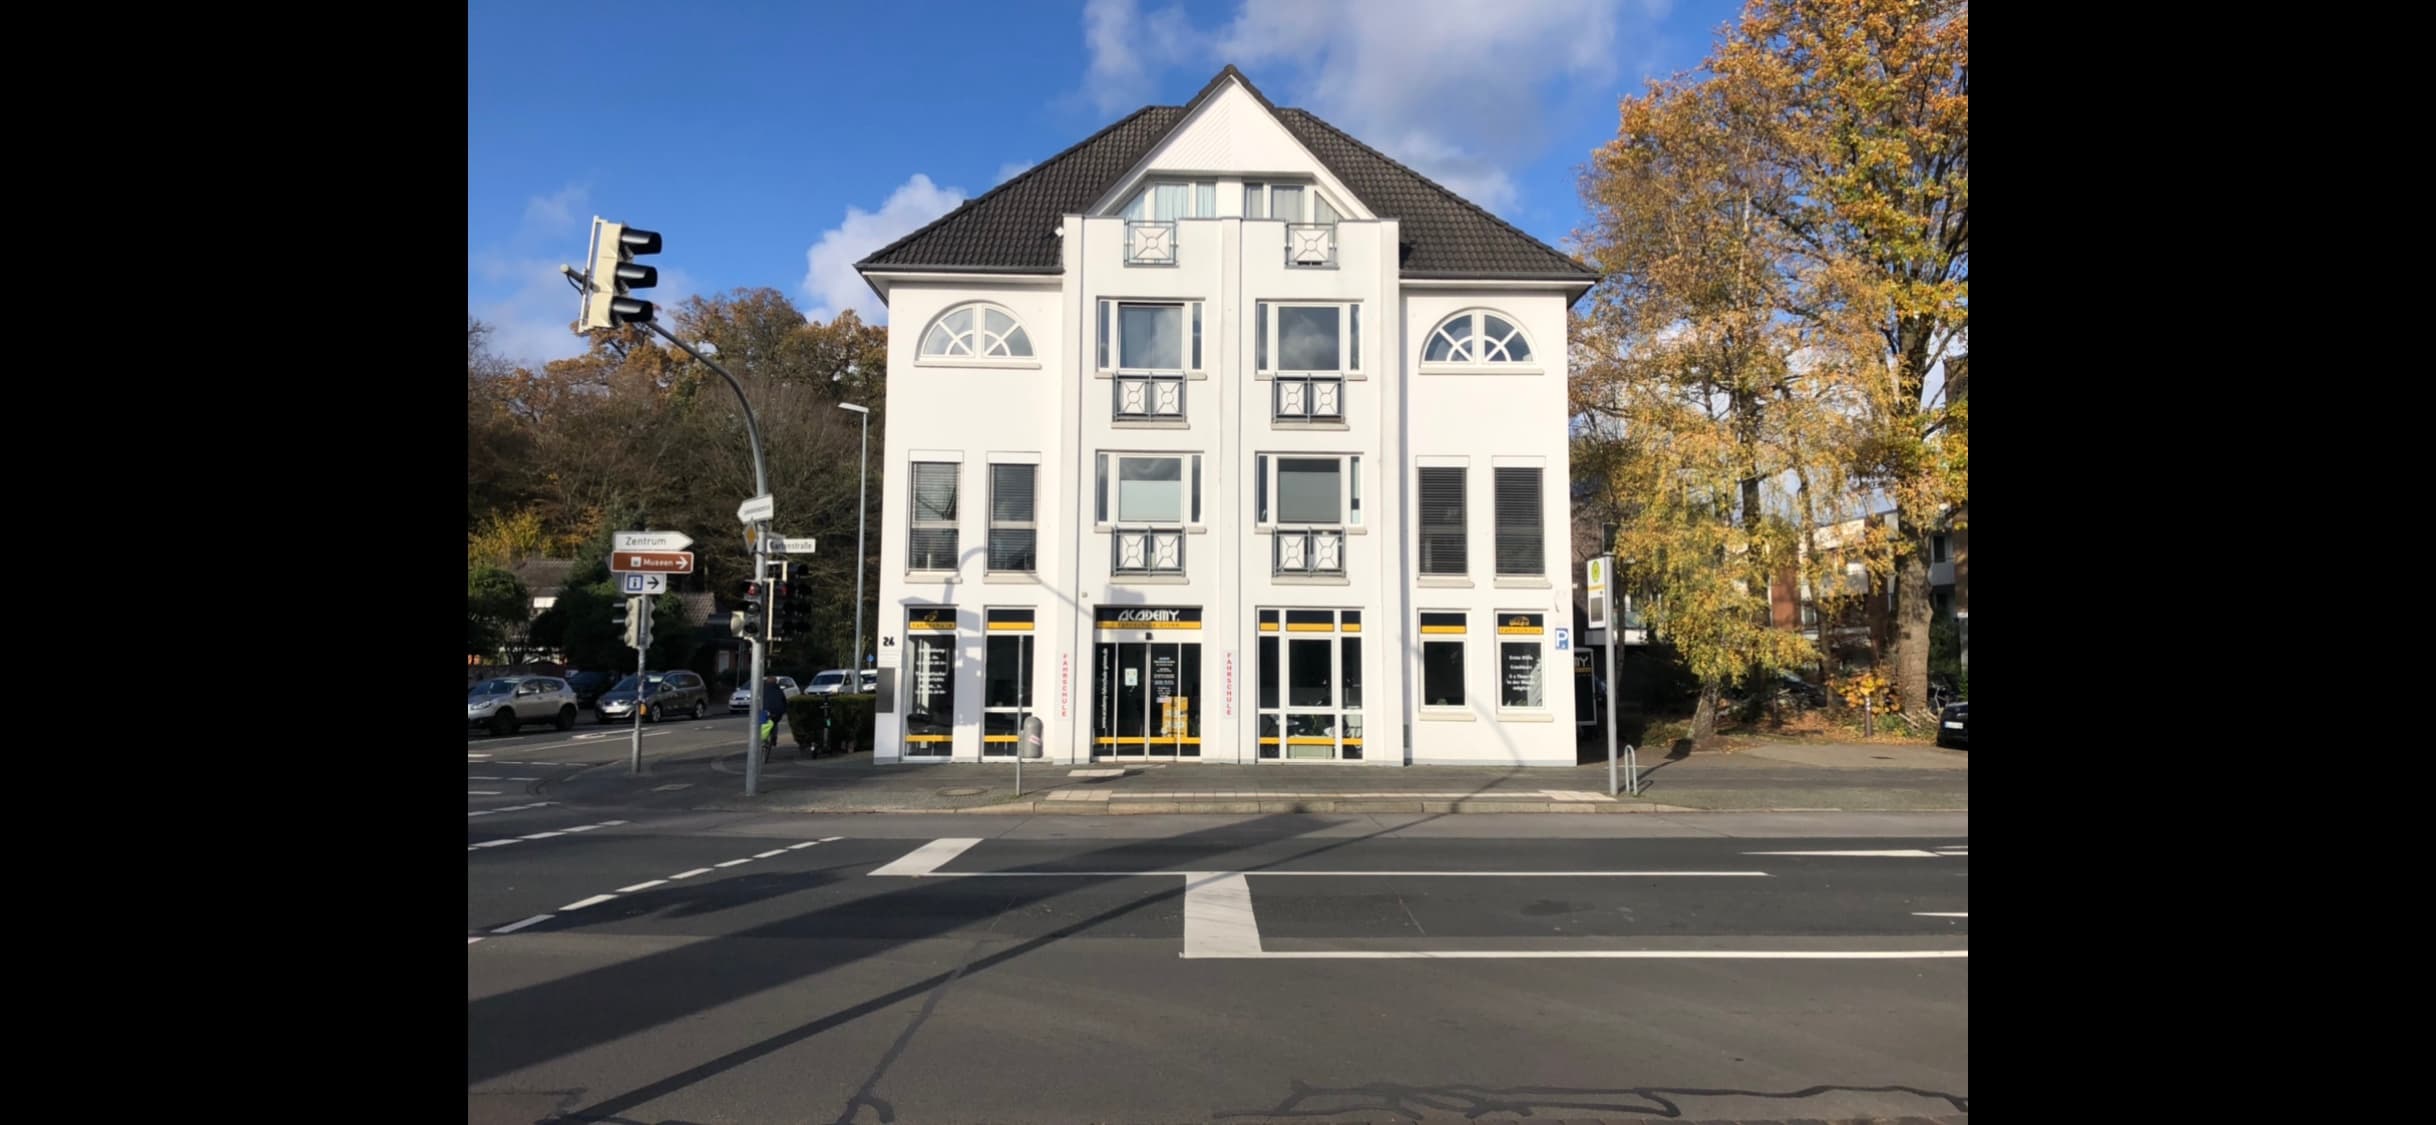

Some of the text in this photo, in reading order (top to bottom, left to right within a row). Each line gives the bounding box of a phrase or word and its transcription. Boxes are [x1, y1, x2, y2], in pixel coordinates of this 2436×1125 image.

[625, 536, 666, 546] Zentrum
[643, 559, 674, 567] Museen
[1556, 630, 1567, 648] P
